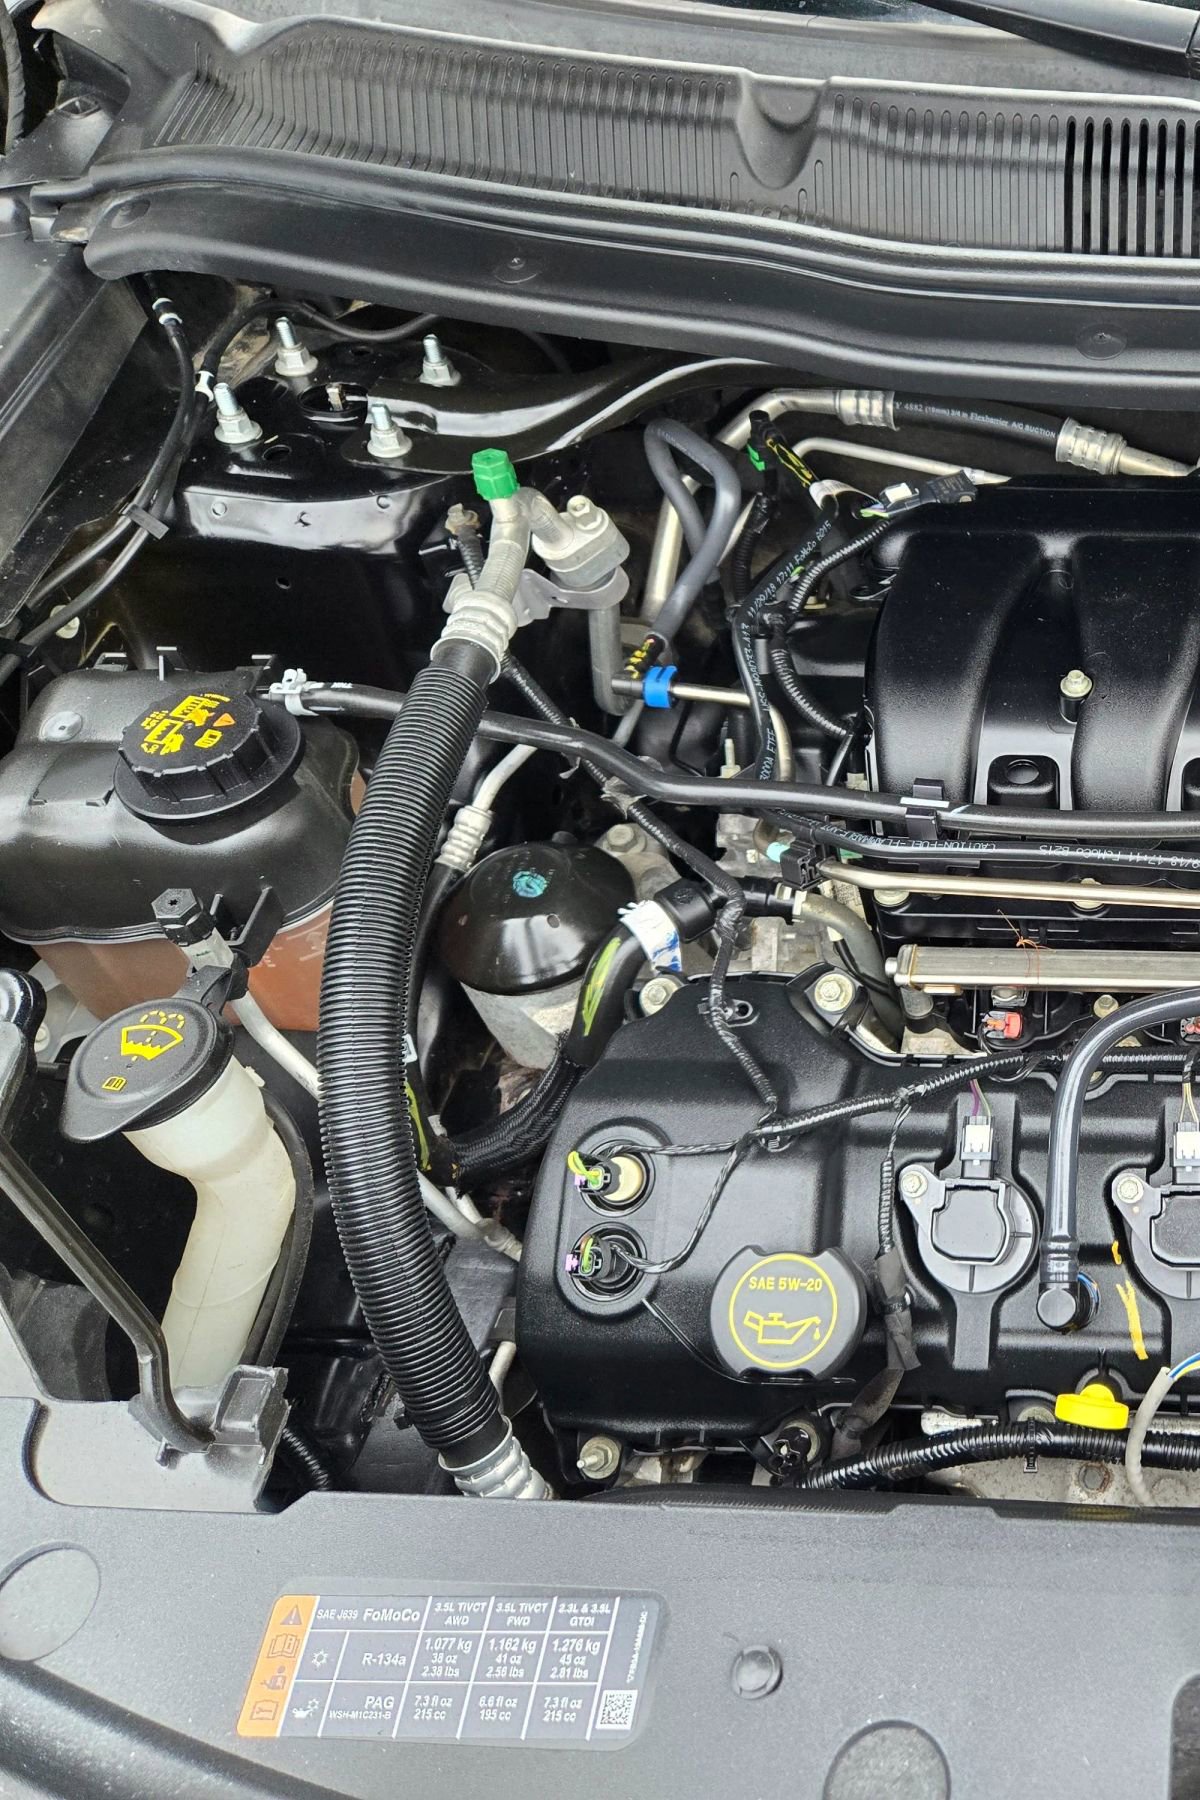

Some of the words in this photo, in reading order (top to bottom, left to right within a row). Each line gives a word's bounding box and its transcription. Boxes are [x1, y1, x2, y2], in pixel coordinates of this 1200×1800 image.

[1011, 421, 1024, 430] A/C
[1024, 423, 1056, 438] SUCTION
[794, 540, 817, 565] FoMoCo
[1040, 845, 1070, 856] B215
[749, 1276, 775, 1290] SAE
[778, 1277, 823, 1291] 5W-20
[434, 1602, 455, 1613] 3.5L
[495, 1602, 516, 1614] 3.5L
[558, 1603, 579, 1614] 2.3L
[581, 1603, 589, 1614] &
[316, 1609, 337, 1620] SAE
[363, 1608, 421, 1622] FoMoCo
[444, 1615, 470, 1626] AWD
[506, 1616, 531, 1627] FWD
[425, 1637, 456, 1651] 1.077
[457, 1637, 473, 1653] kg
[489, 1637, 519, 1651] 1.162
[521, 1638, 537, 1654] kg
[552, 1638, 584, 1652] 1.276
[585, 1638, 601, 1655] kg
[362, 1652, 407, 1666] R-134a
[431, 1653, 444, 1664] 38
[445, 1655, 458, 1664] oz
[495, 1653, 508, 1664] 41
[510, 1655, 522, 1665] oz
[559, 1653, 573, 1666] 45
[573, 1656, 587, 1666] oz
[421, 1666, 443, 1678] 2.38
[444, 1666, 460, 1678] lbs
[509, 1666, 525, 1678] lbs
[572, 1667, 589, 1679] lbs
[364, 1695, 395, 1710] PAG
[414, 1695, 430, 1707] 7.3
[431, 1695, 440, 1706] fl
[441, 1697, 453, 1707] oz
[479, 1696, 495, 1708] 6.6
[496, 1696, 504, 1707] fl
[505, 1698, 518, 1708] oz
[543, 1697, 560, 1709] 7.3
[560, 1697, 569, 1708] fl
[569, 1698, 583, 1709] oz
[413, 1708, 432, 1720] 215
[434, 1710, 447, 1720] cc
[479, 1708, 498, 1720] 195
[498, 1711, 512, 1721] cc
[543, 1709, 562, 1722] 215
[563, 1712, 577, 1722] cc
